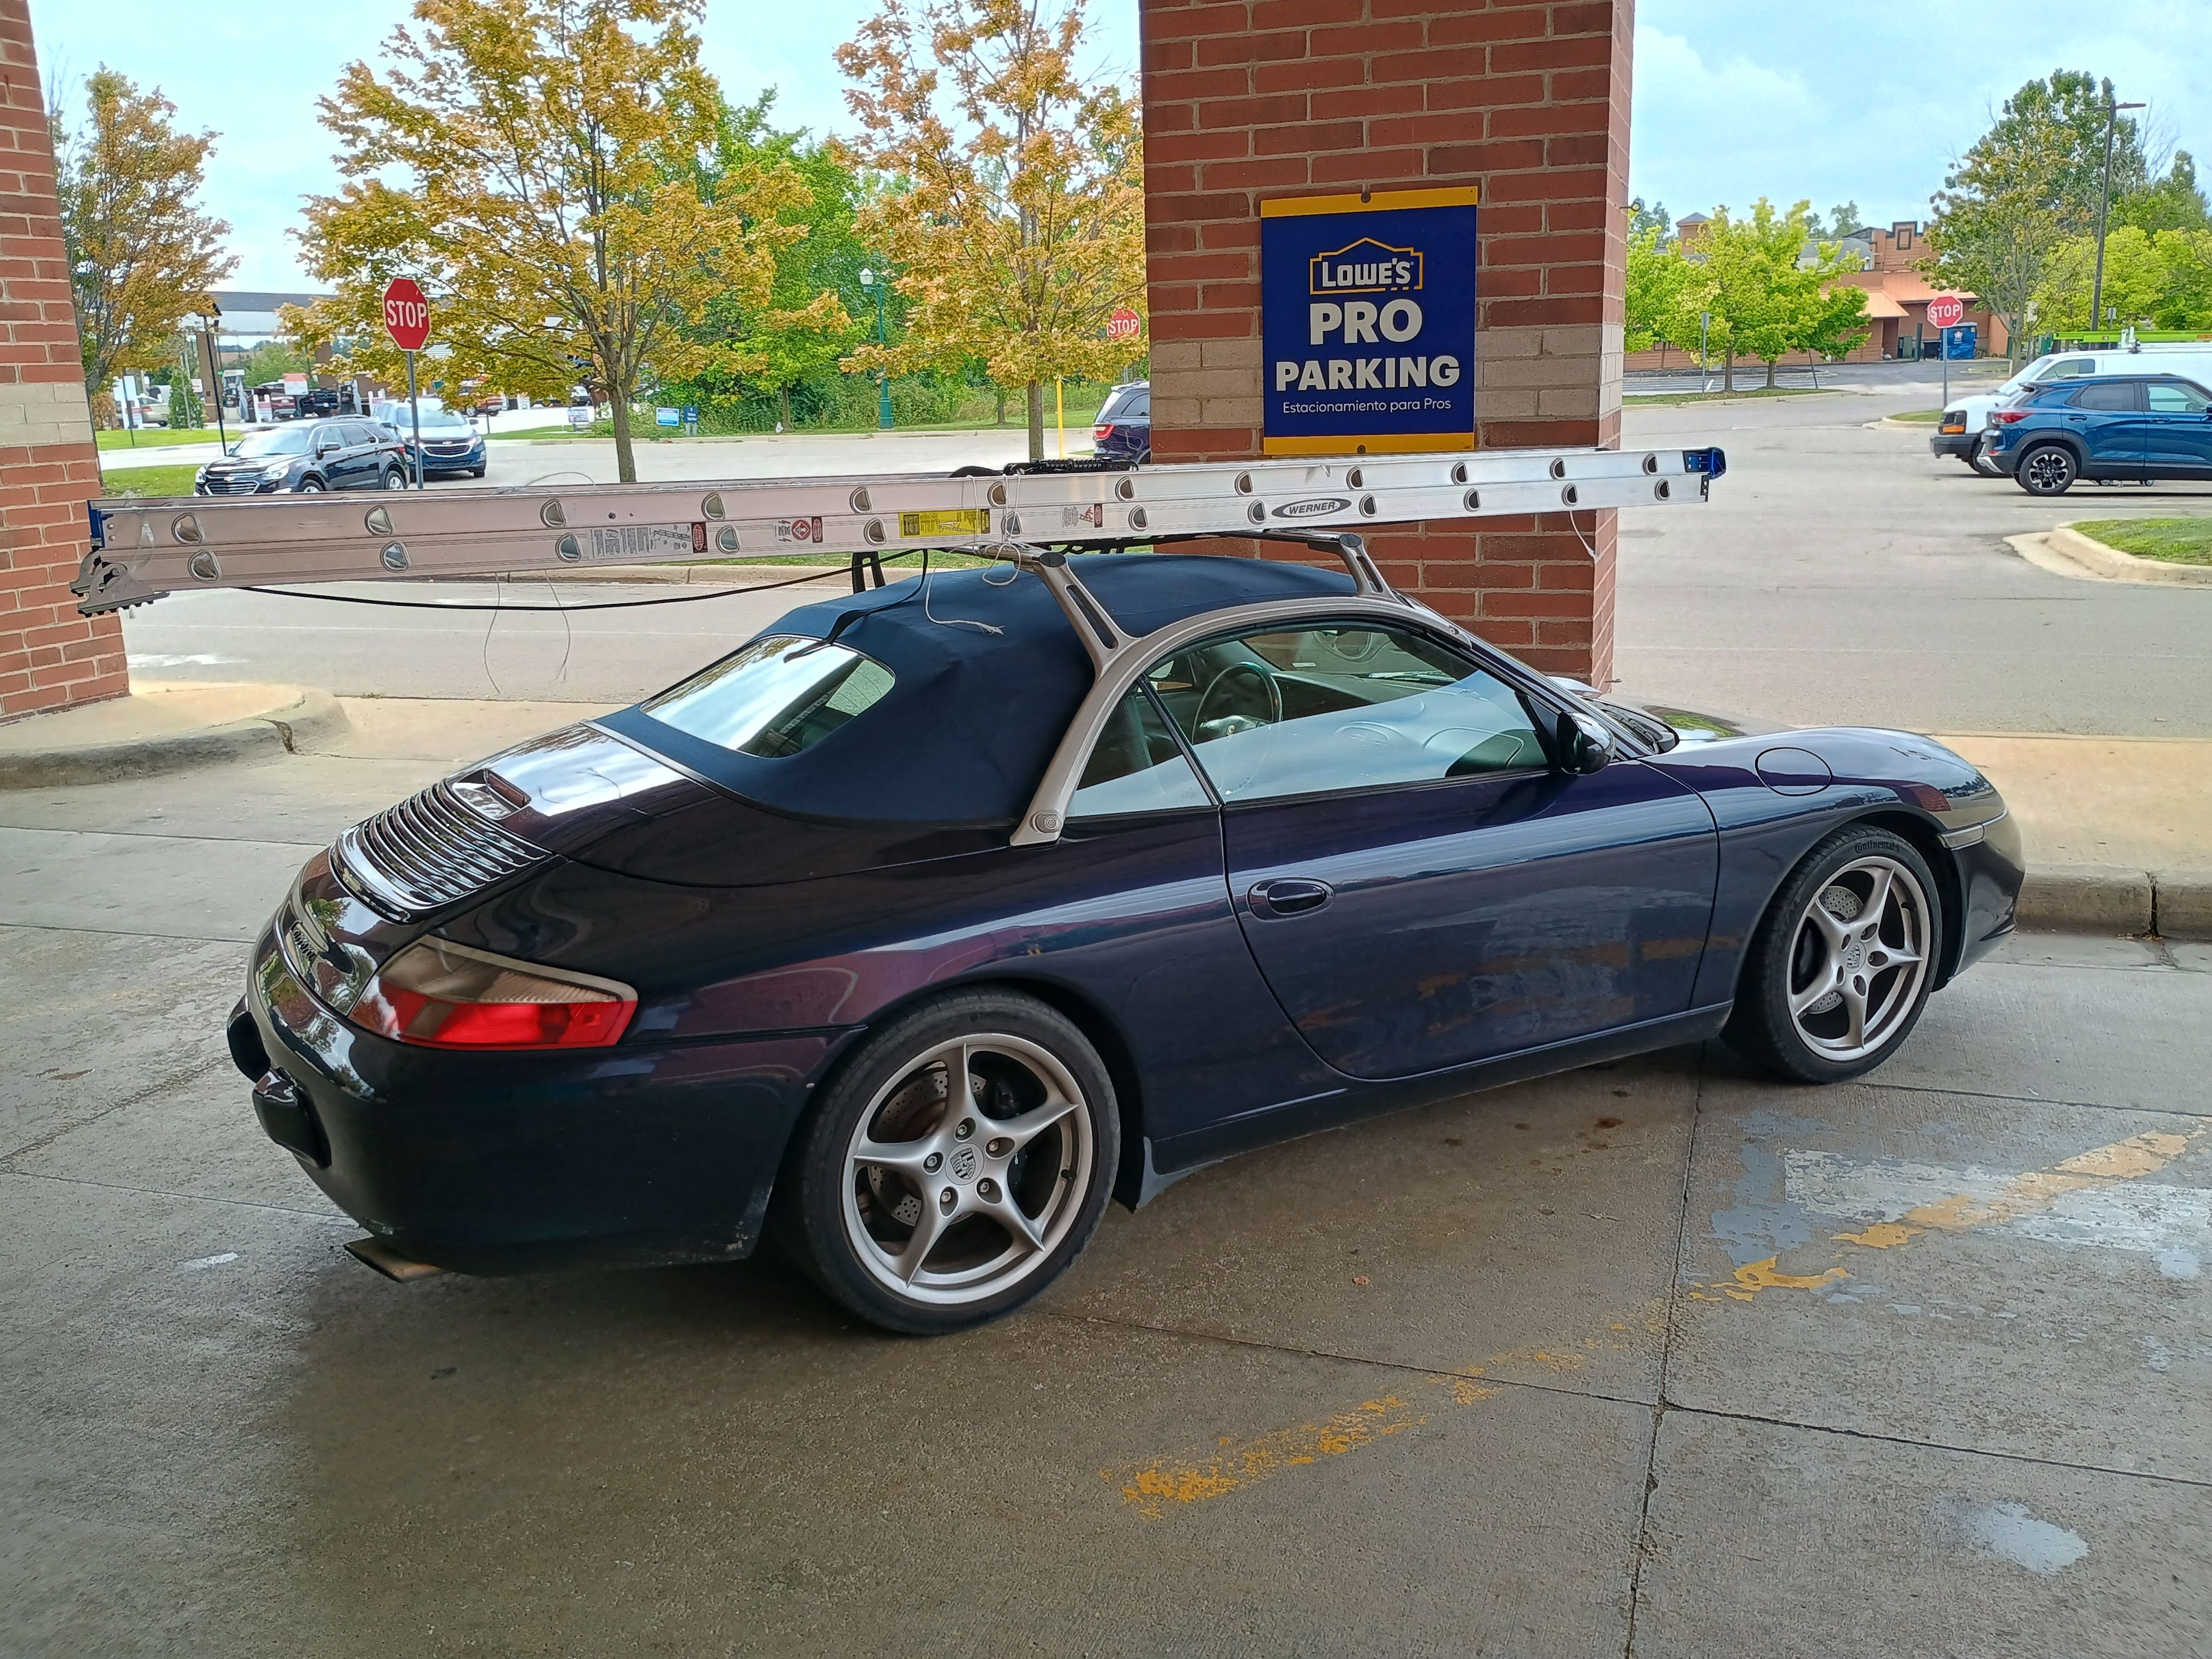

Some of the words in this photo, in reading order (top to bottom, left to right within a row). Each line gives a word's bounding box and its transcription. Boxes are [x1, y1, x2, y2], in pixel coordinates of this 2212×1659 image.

[1322, 258, 1411, 287] LOWE'S
[386, 299, 427, 328] STOP
[1310, 299, 1423, 345] PRO
[1930, 304, 1960, 319] STOP
[1109, 319, 1138, 334] STOP
[1276, 355, 1460, 392] PARKING
[1283, 400, 1387, 414] Estacionamiento
[1390, 399, 1420, 413] para
[1424, 397, 1452, 410] Pros
[1289, 502, 1336, 515] WERNER
